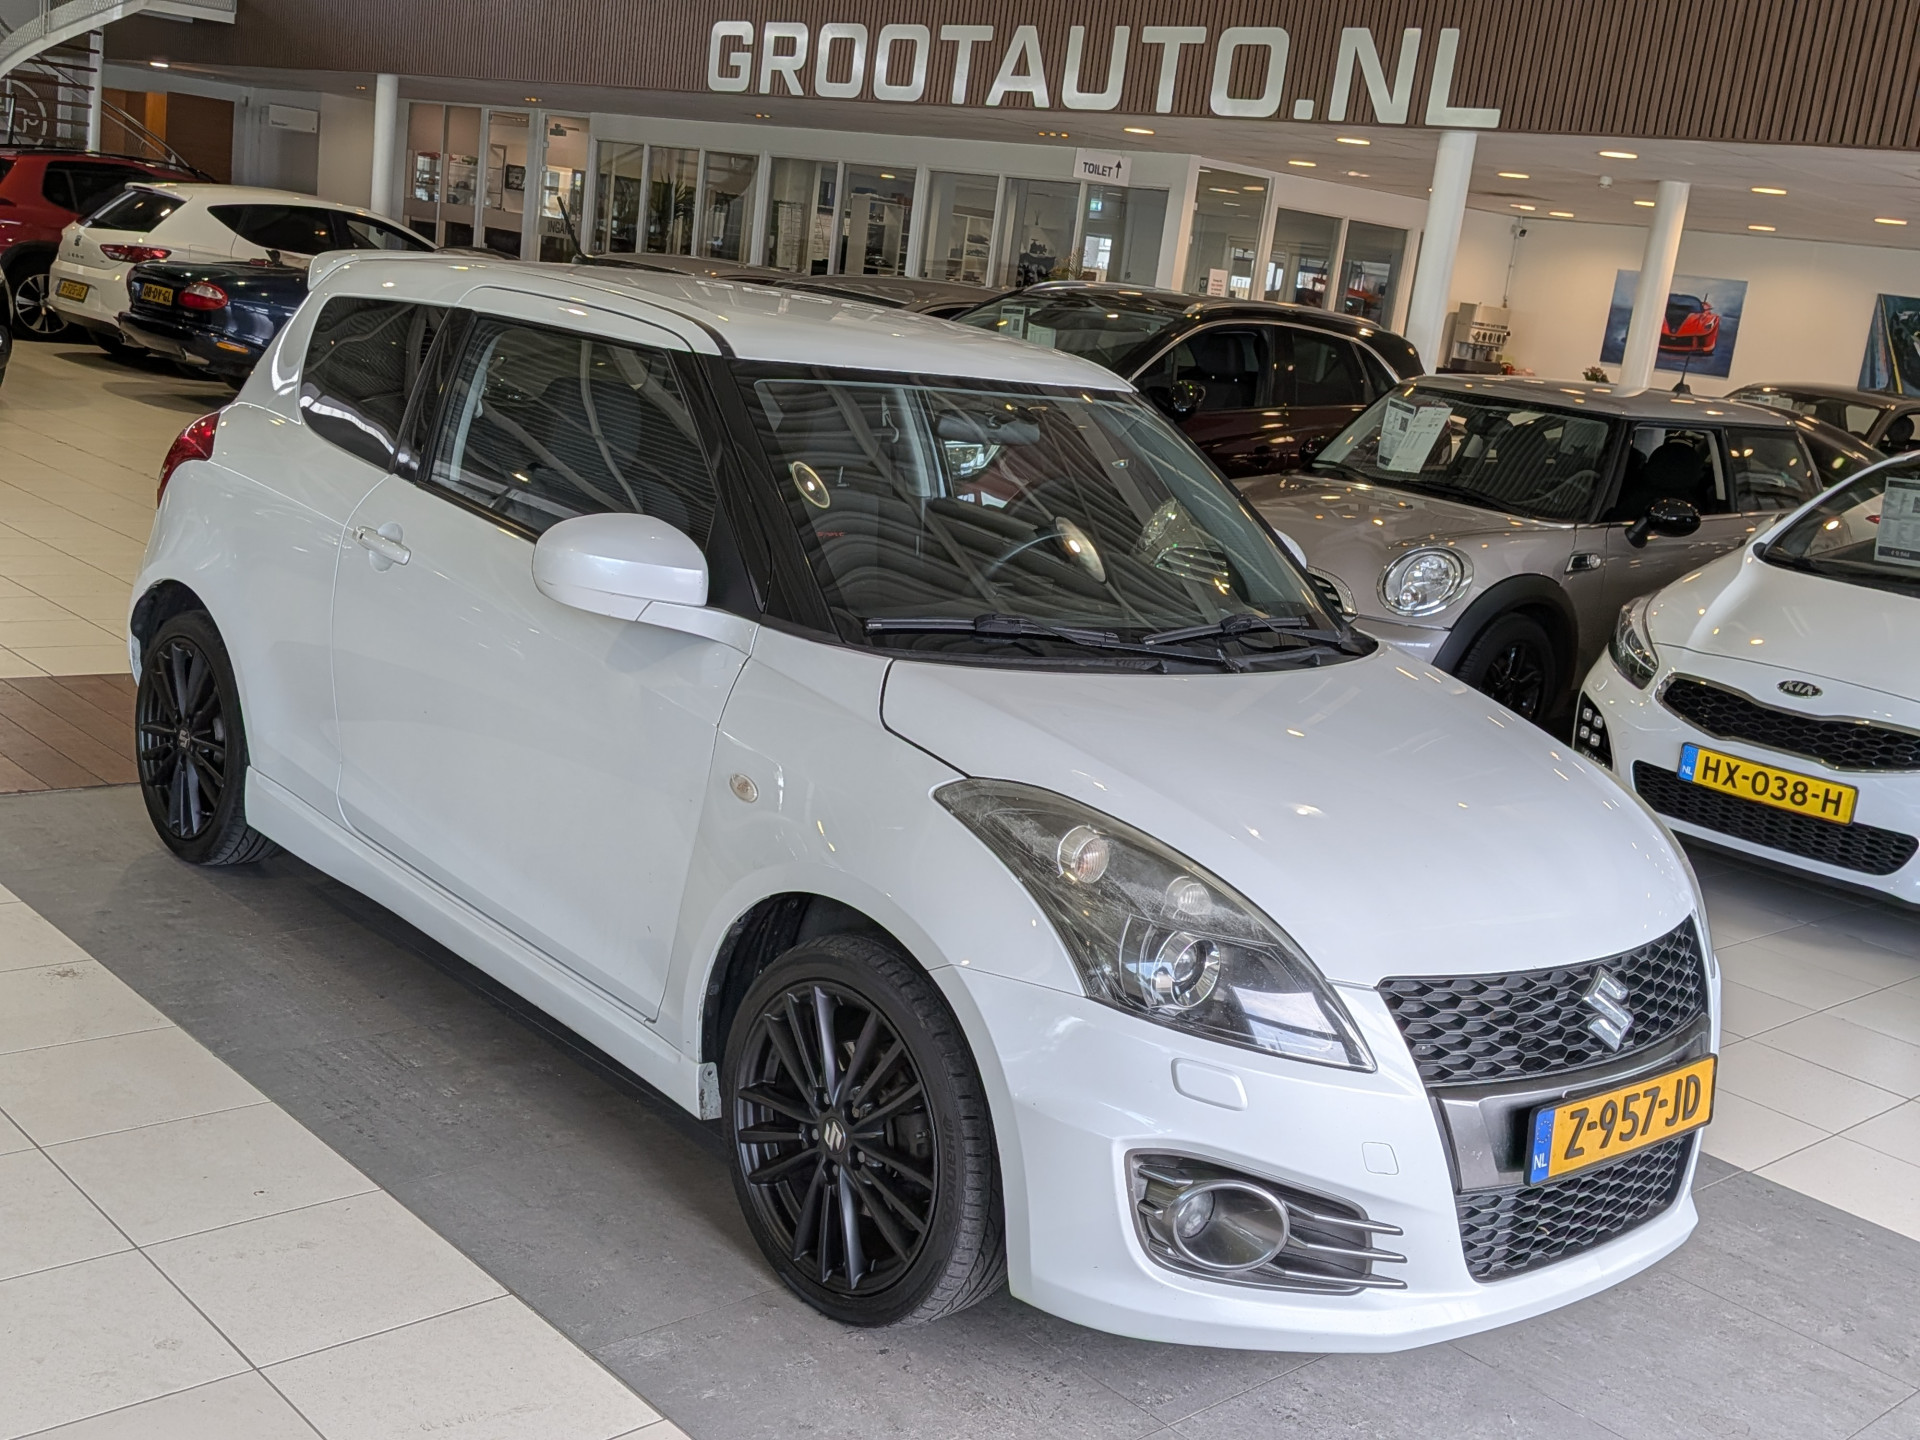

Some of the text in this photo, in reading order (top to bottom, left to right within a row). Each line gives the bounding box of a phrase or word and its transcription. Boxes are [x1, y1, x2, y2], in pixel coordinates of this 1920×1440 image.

[708, 20, 1501, 128] GROOTAUTO.NL
[1083, 162, 1113, 177] TOILET
[1783, 680, 1814, 696] KIA
[1682, 765, 1693, 776] NL
[1702, 756, 1843, 816] HX-038-H
[1564, 1074, 1701, 1160] Z-957-JD
[1533, 1153, 1548, 1171] NL
